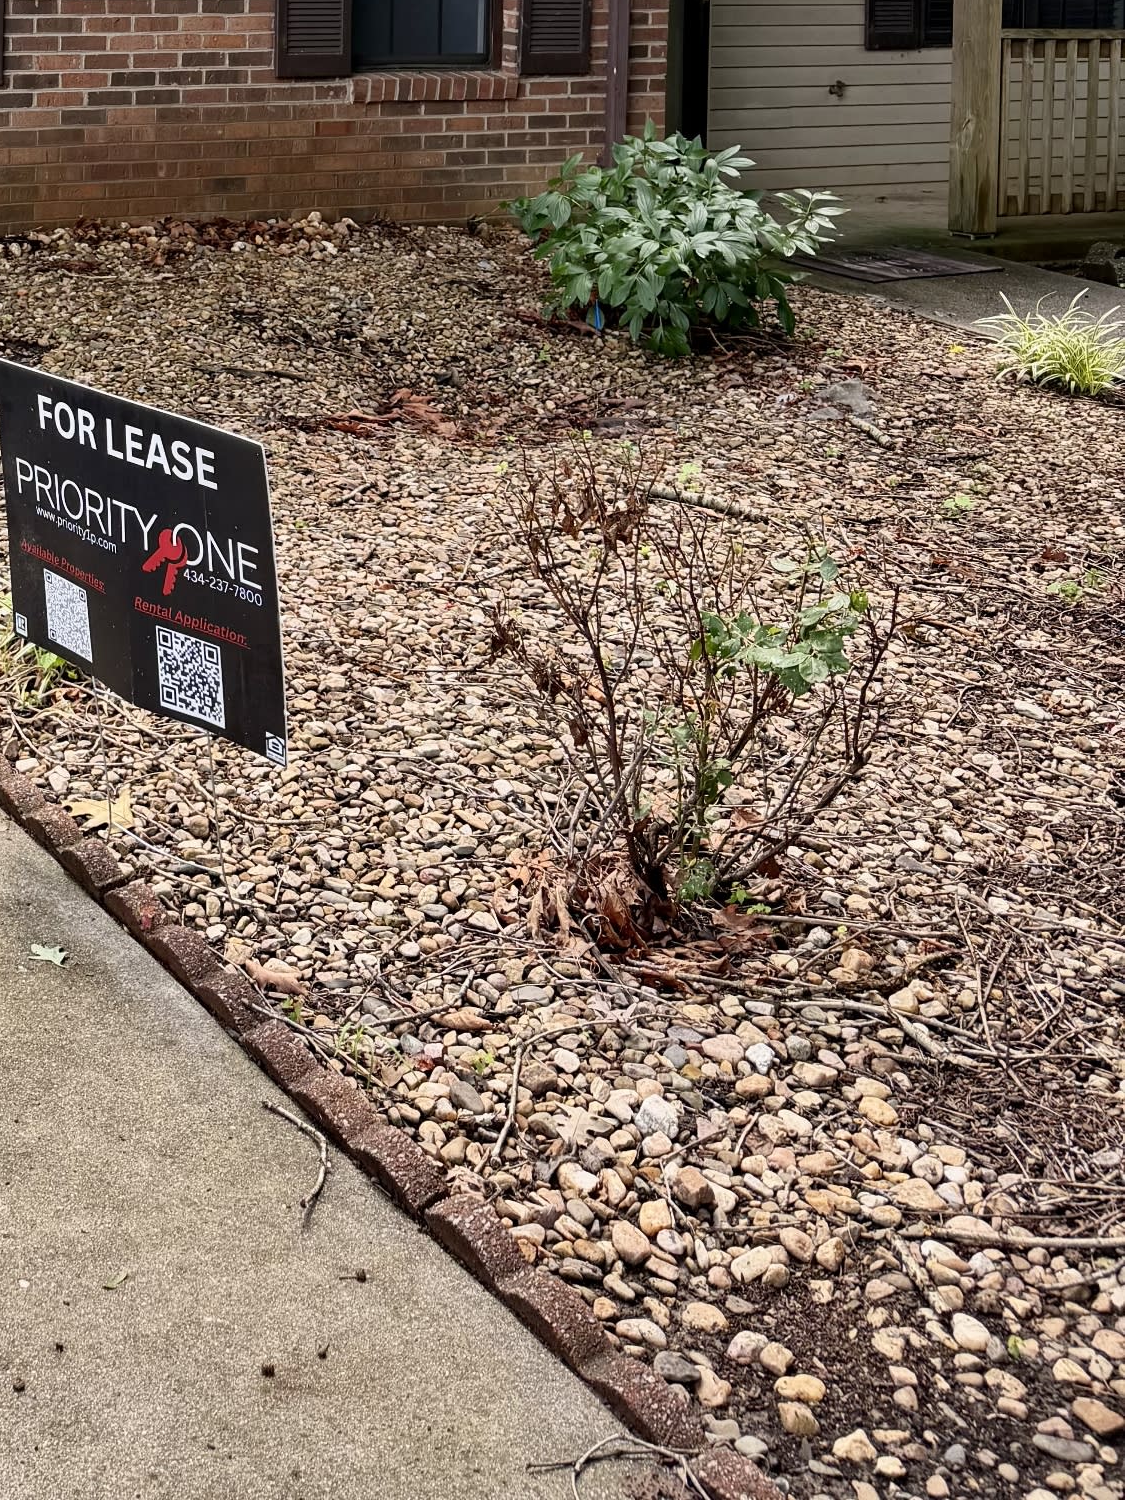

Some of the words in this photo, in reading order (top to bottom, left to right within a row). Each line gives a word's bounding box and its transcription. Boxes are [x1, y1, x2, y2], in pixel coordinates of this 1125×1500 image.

[37, 393, 97, 450] FOR
[105, 417, 218, 491] LEASE
[15, 456, 158, 551] PRIORITY
[172, 522, 262, 591] ONE
[35, 504, 117, 554] www.priority1p.com
[20, 538, 60, 566] Available
[134, 595, 172, 620] Rental
[183, 567, 263, 607] 434-237-7800
